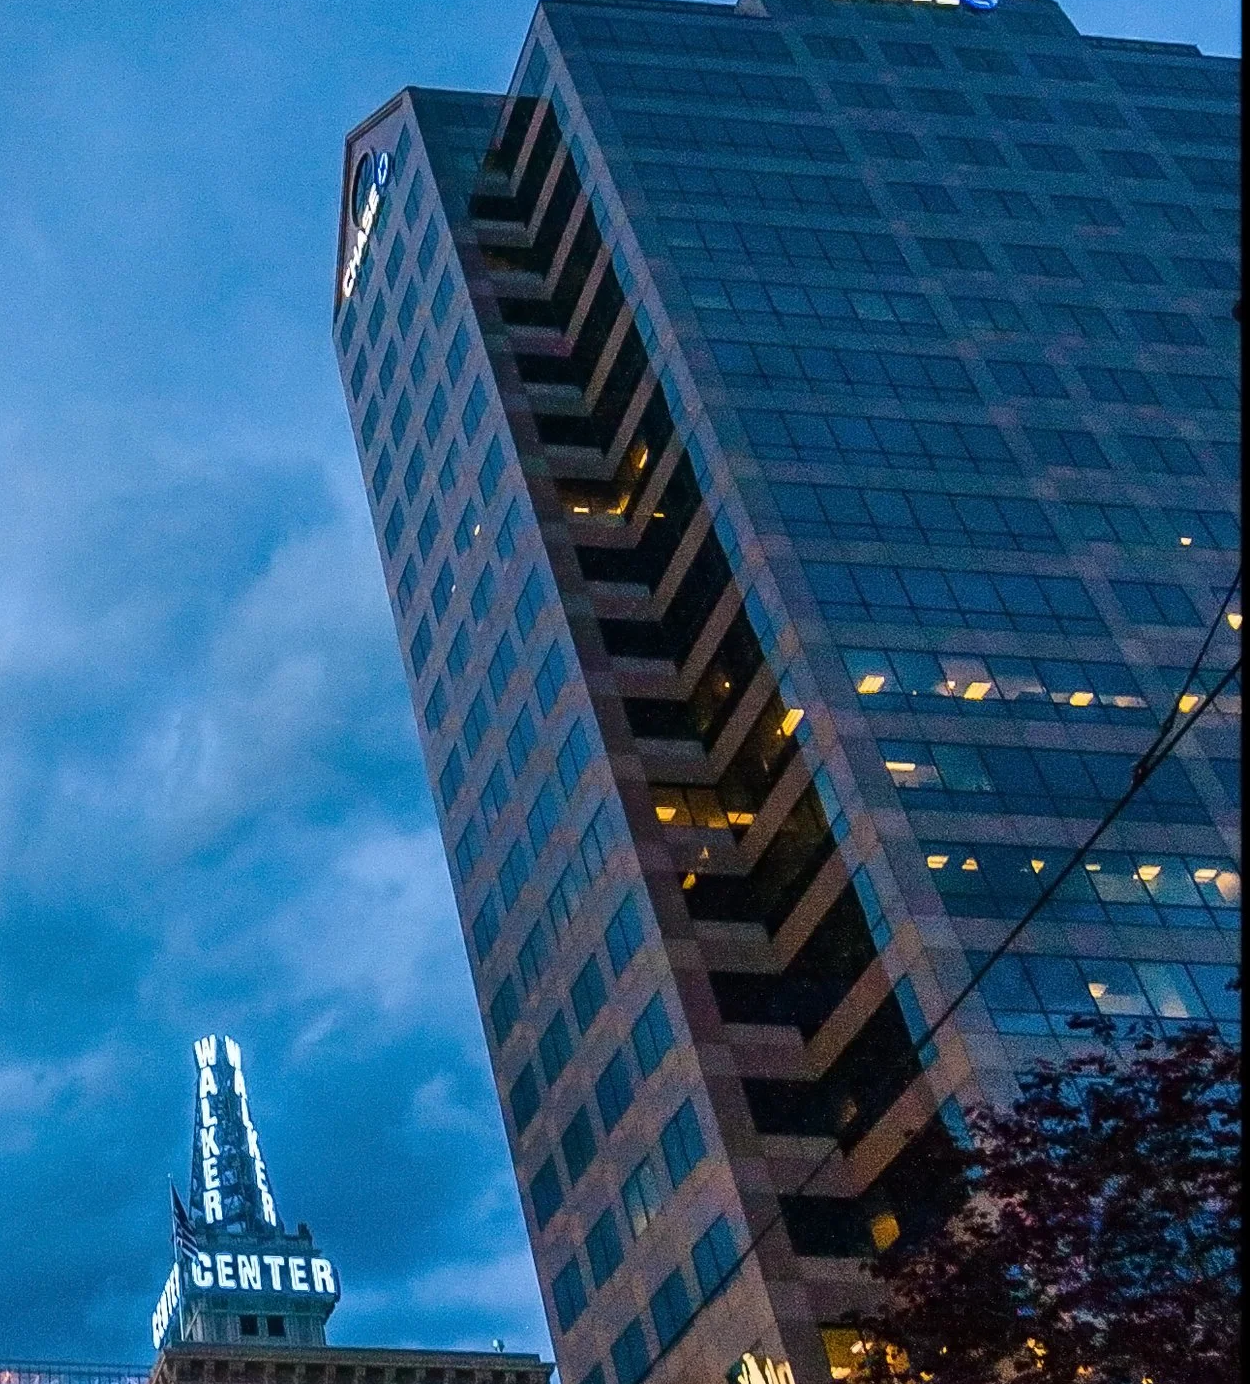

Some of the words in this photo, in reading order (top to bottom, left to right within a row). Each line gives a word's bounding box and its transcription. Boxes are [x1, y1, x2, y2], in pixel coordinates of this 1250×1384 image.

[193, 1034, 224, 1225] WALKER
[225, 1034, 277, 1227] WALKER
[191, 1251, 337, 1294] CENTER
